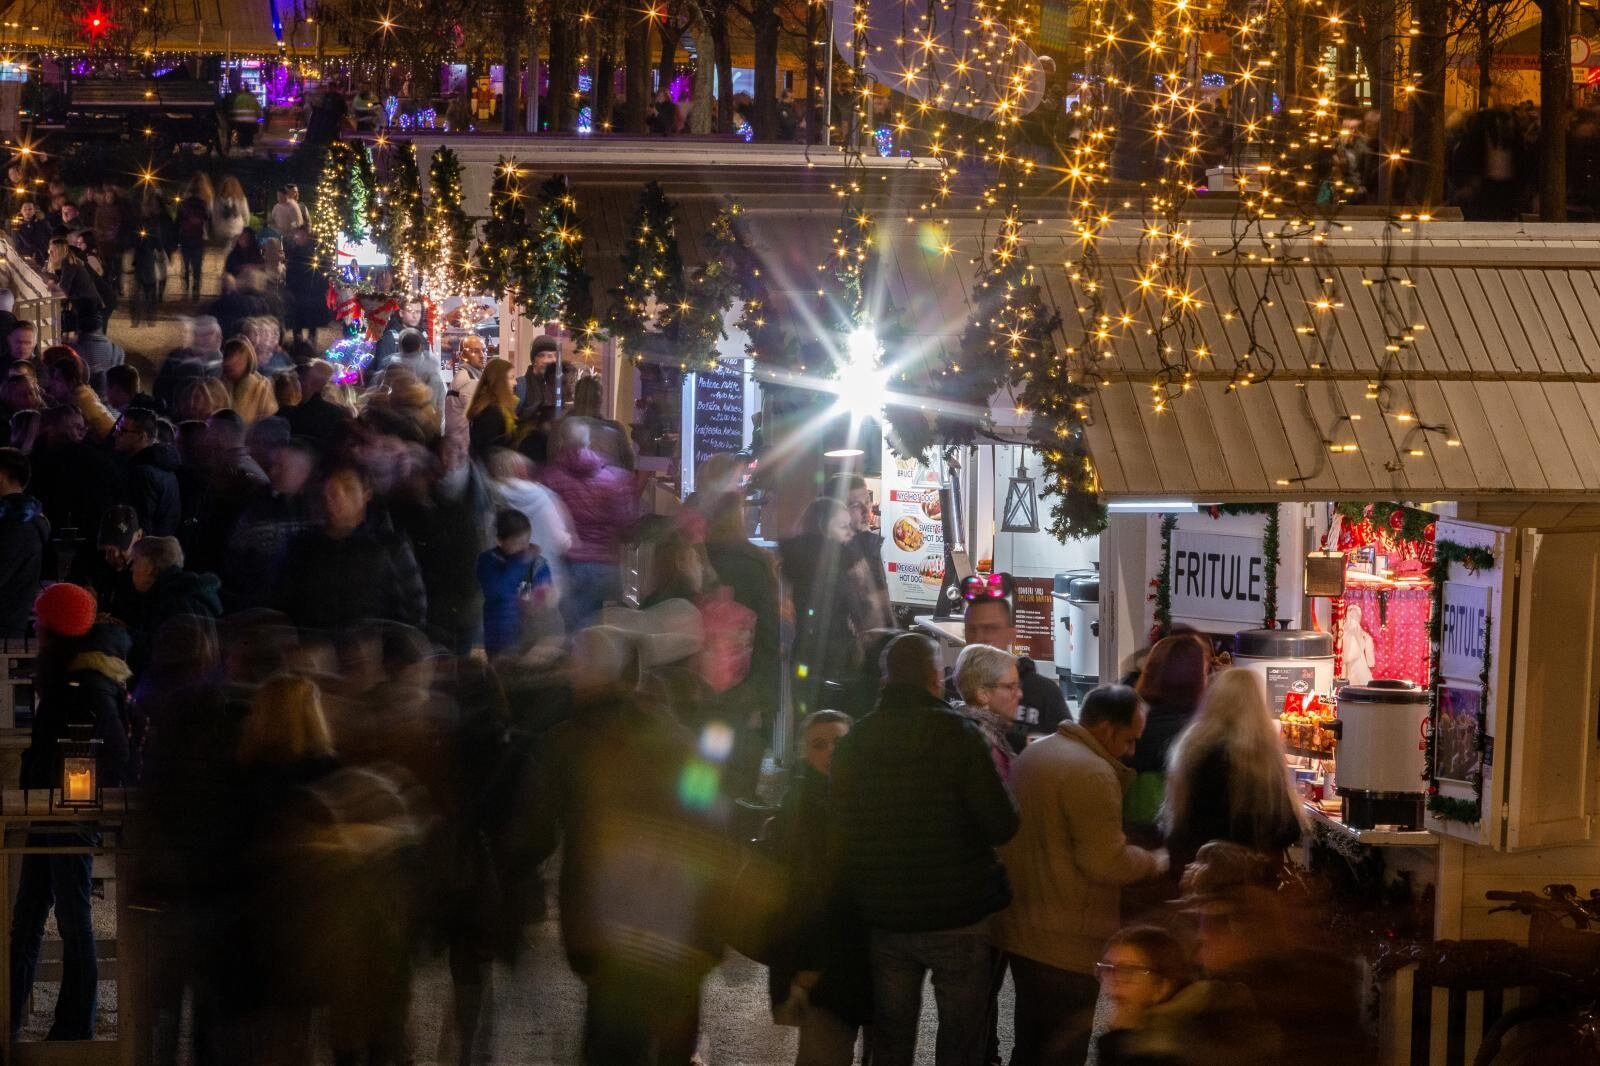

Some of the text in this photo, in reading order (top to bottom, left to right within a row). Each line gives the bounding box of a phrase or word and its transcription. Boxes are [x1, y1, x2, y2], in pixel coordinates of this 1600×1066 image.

[923, 534, 934, 542] HOT
[900, 574, 922, 583] HOT DOG
[1175, 551, 1261, 601] FRITULE
[1443, 604, 1484, 657] FRITULE
